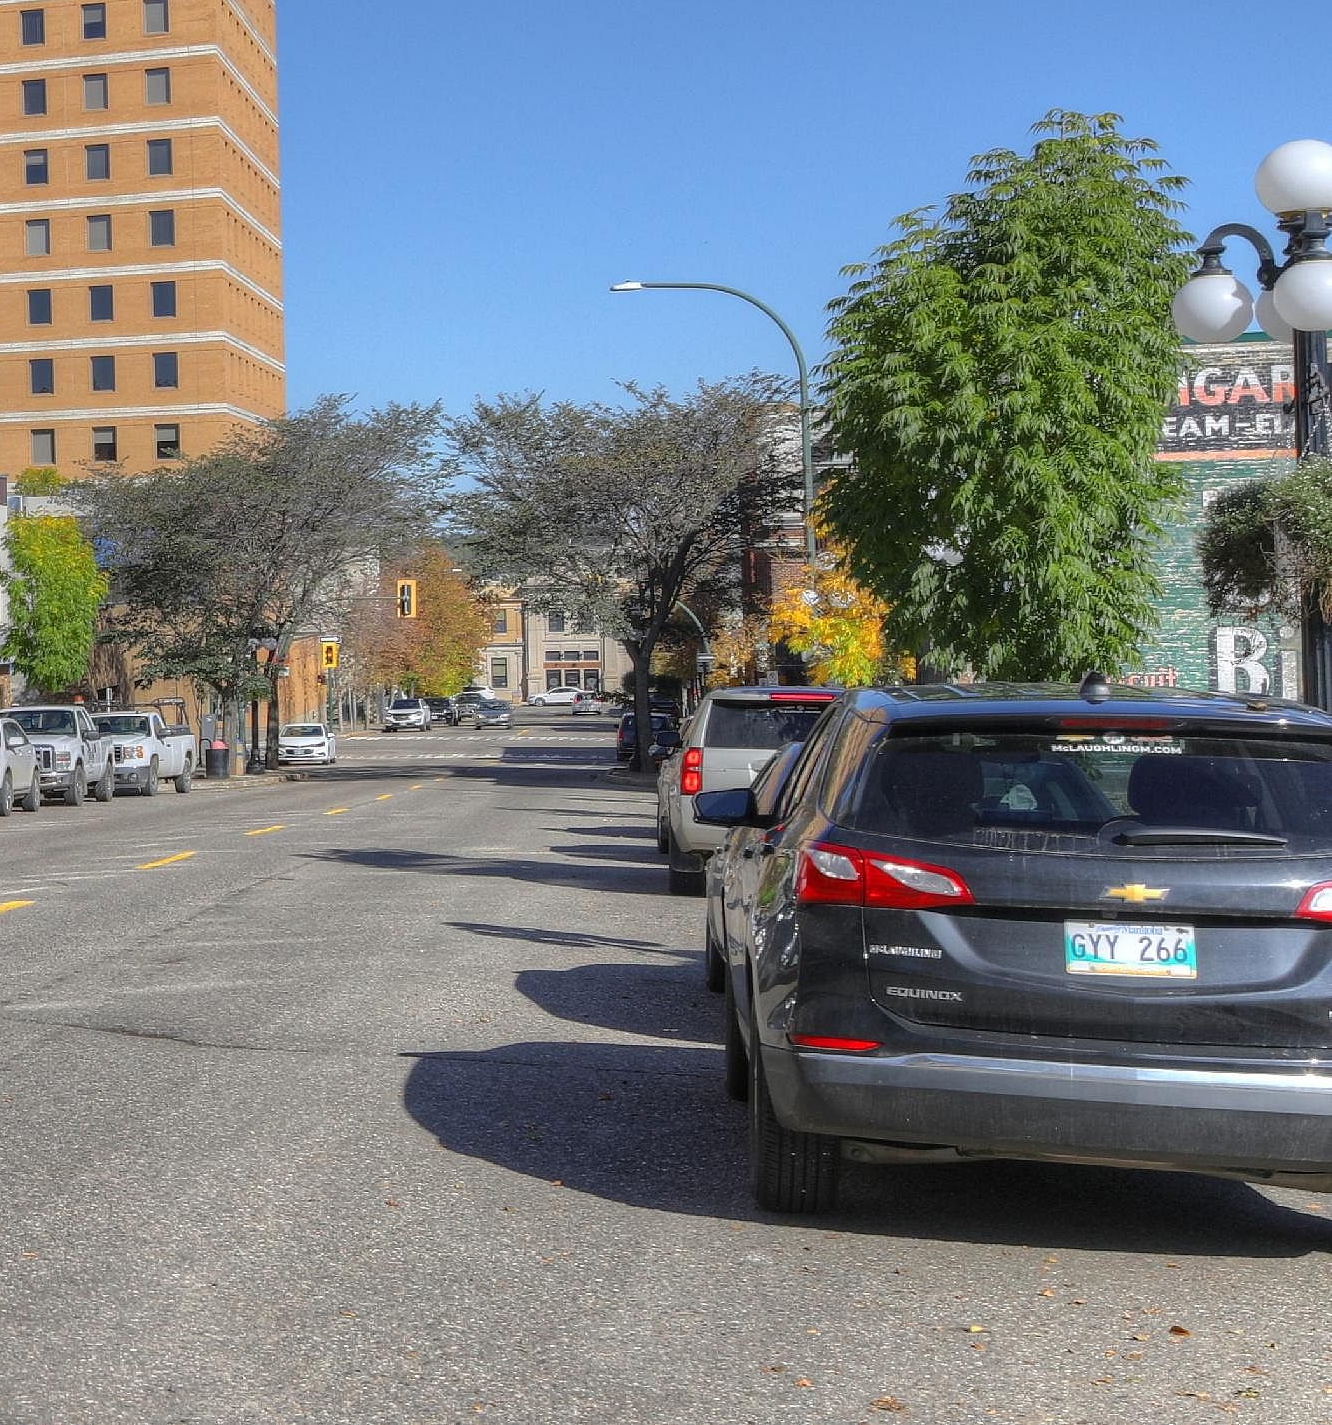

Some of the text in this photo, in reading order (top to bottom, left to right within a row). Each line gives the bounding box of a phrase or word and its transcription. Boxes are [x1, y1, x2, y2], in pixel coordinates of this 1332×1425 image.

[1072, 934, 1188, 963] GYY 266
[886, 986, 963, 1002] EQUINOX
